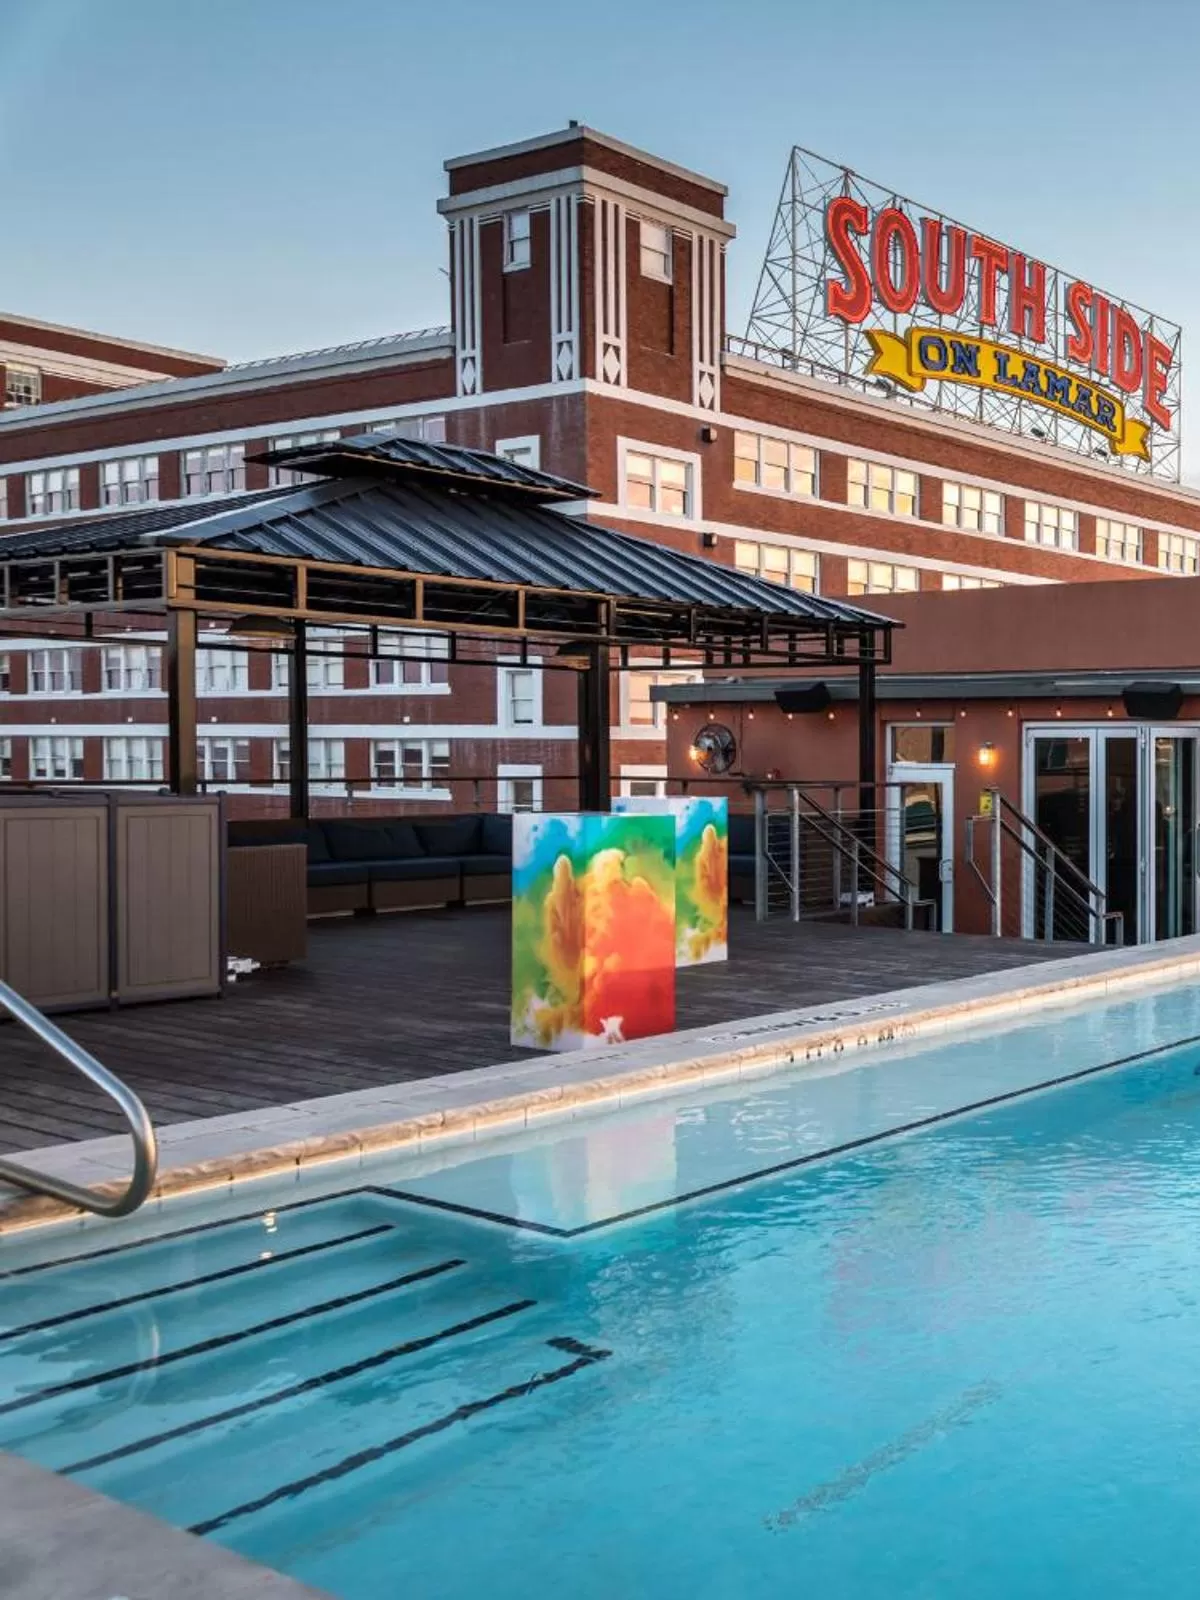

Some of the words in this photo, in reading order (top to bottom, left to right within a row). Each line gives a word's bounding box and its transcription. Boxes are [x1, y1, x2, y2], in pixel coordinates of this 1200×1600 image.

[825, 197, 1046, 343] SOUTH
[1065, 282, 1172, 430] SIDE
[919, 335, 980, 376] ON
[995, 352, 1116, 430] LAMAR
